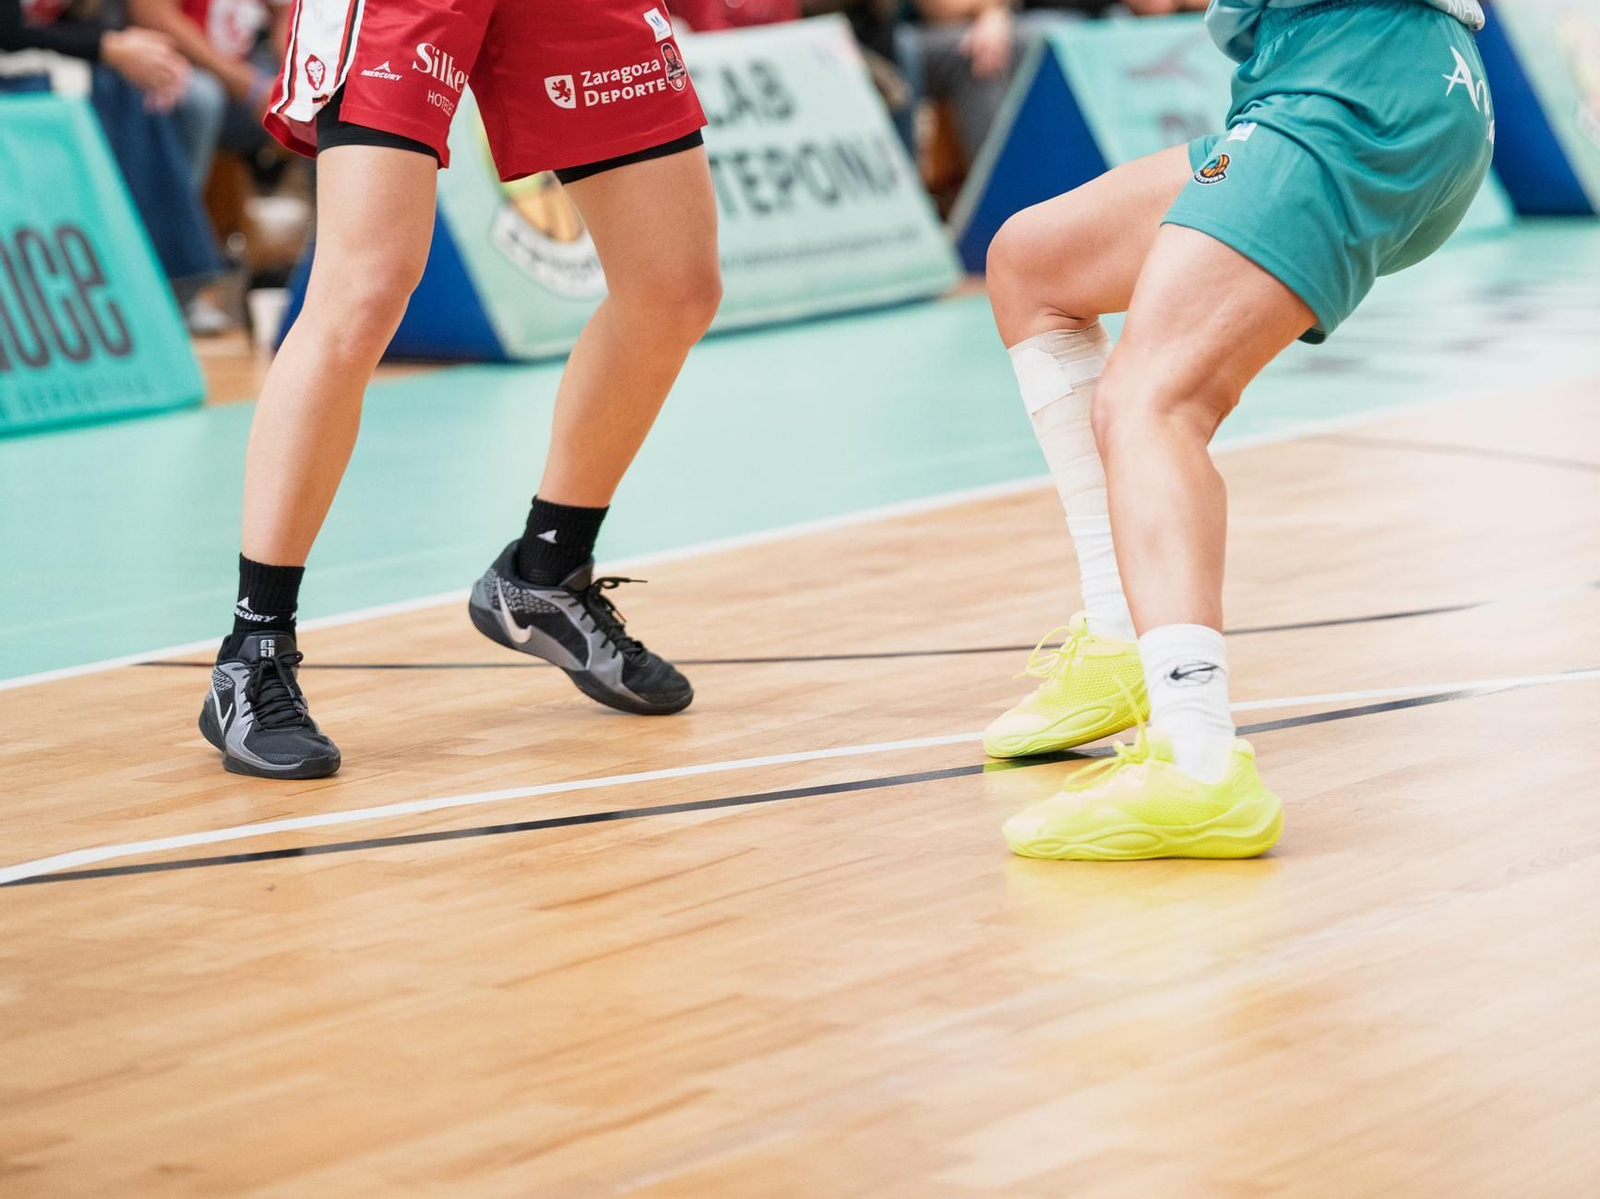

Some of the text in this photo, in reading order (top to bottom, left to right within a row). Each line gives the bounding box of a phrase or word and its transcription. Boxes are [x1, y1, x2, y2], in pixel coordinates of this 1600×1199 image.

[360, 68, 403, 81] MERCURY
[580, 58, 662, 87] Zaragoza
[583, 77, 667, 107] DEPORTE
